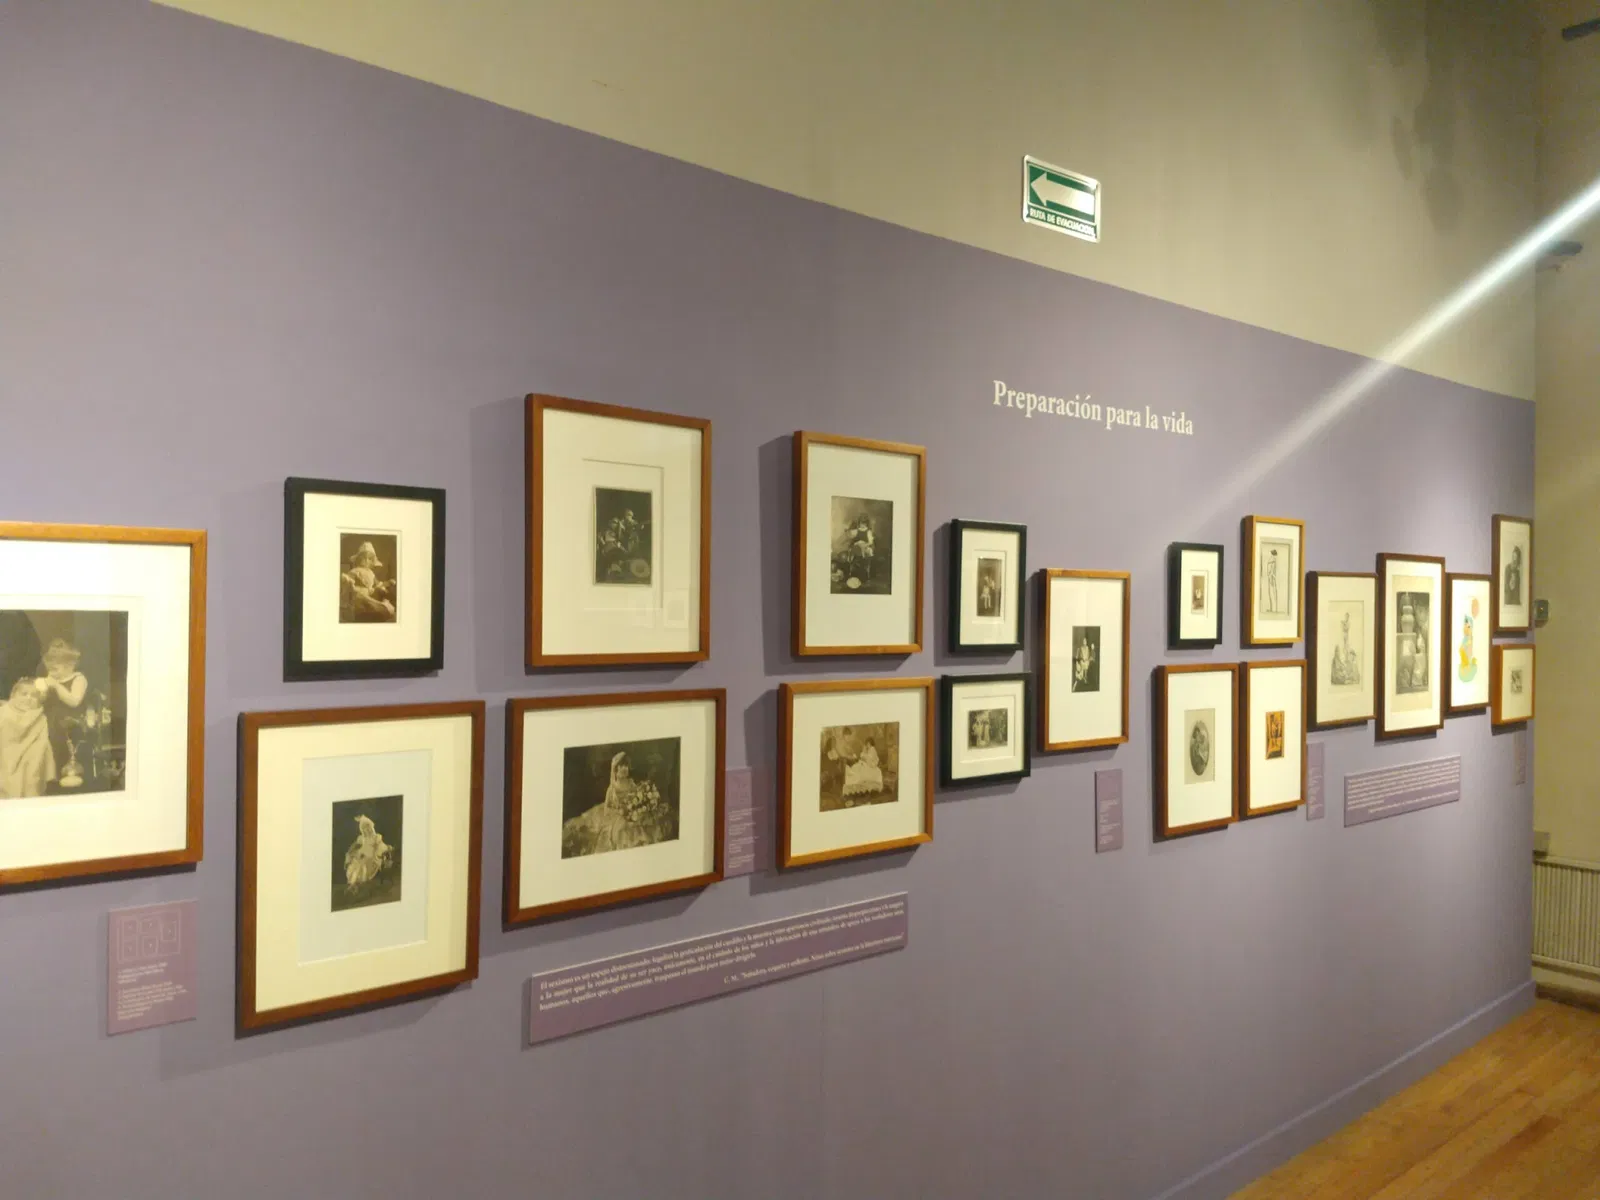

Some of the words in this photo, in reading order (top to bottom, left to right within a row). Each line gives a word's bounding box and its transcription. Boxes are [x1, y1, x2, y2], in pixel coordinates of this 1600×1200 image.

[1030, 208, 1046, 221] RUTA
[1047, 213, 1056, 224] DE
[993, 380, 1102, 421] Preparación
[1106, 405, 1141, 430] para
[1145, 405, 1159, 430] la
[1163, 411, 1194, 435] vida
